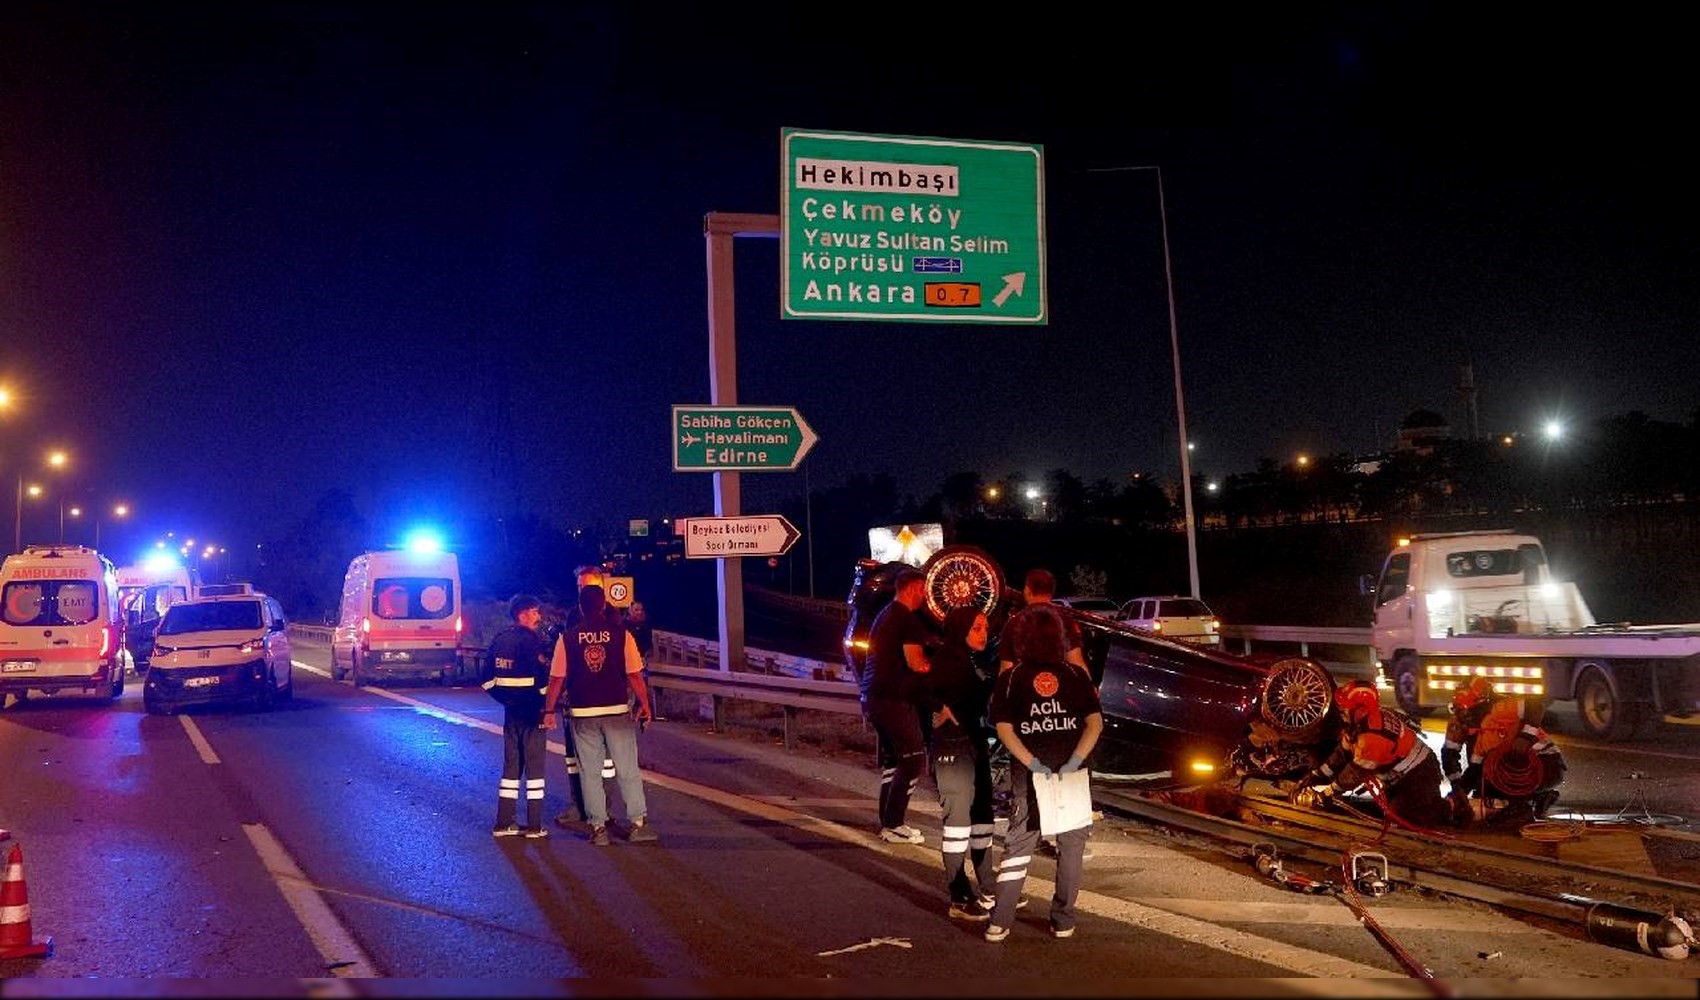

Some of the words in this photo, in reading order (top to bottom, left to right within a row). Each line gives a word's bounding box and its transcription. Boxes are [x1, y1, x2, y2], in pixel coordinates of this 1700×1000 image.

[801, 164, 954, 193] Hekimbaşı
[802, 198, 961, 230] Çekmeköy
[804, 228, 872, 249] Yavuz
[877, 231, 945, 251] Sultan
[950, 235, 1009, 254] Selim
[802, 252, 904, 275] Köprüsü
[803, 280, 915, 303] Ankara
[681, 415, 731, 428] Sabiha
[737, 415, 791, 430] Gökçen
[705, 432, 788, 445] Havalimanı
[706, 448, 767, 464] Edirne
[12, 568, 87, 579] AMBULANS
[614, 587, 625, 596] 70
[1030, 698, 1067, 717] ACİL
[1020, 715, 1077, 735] SAĞLIK
